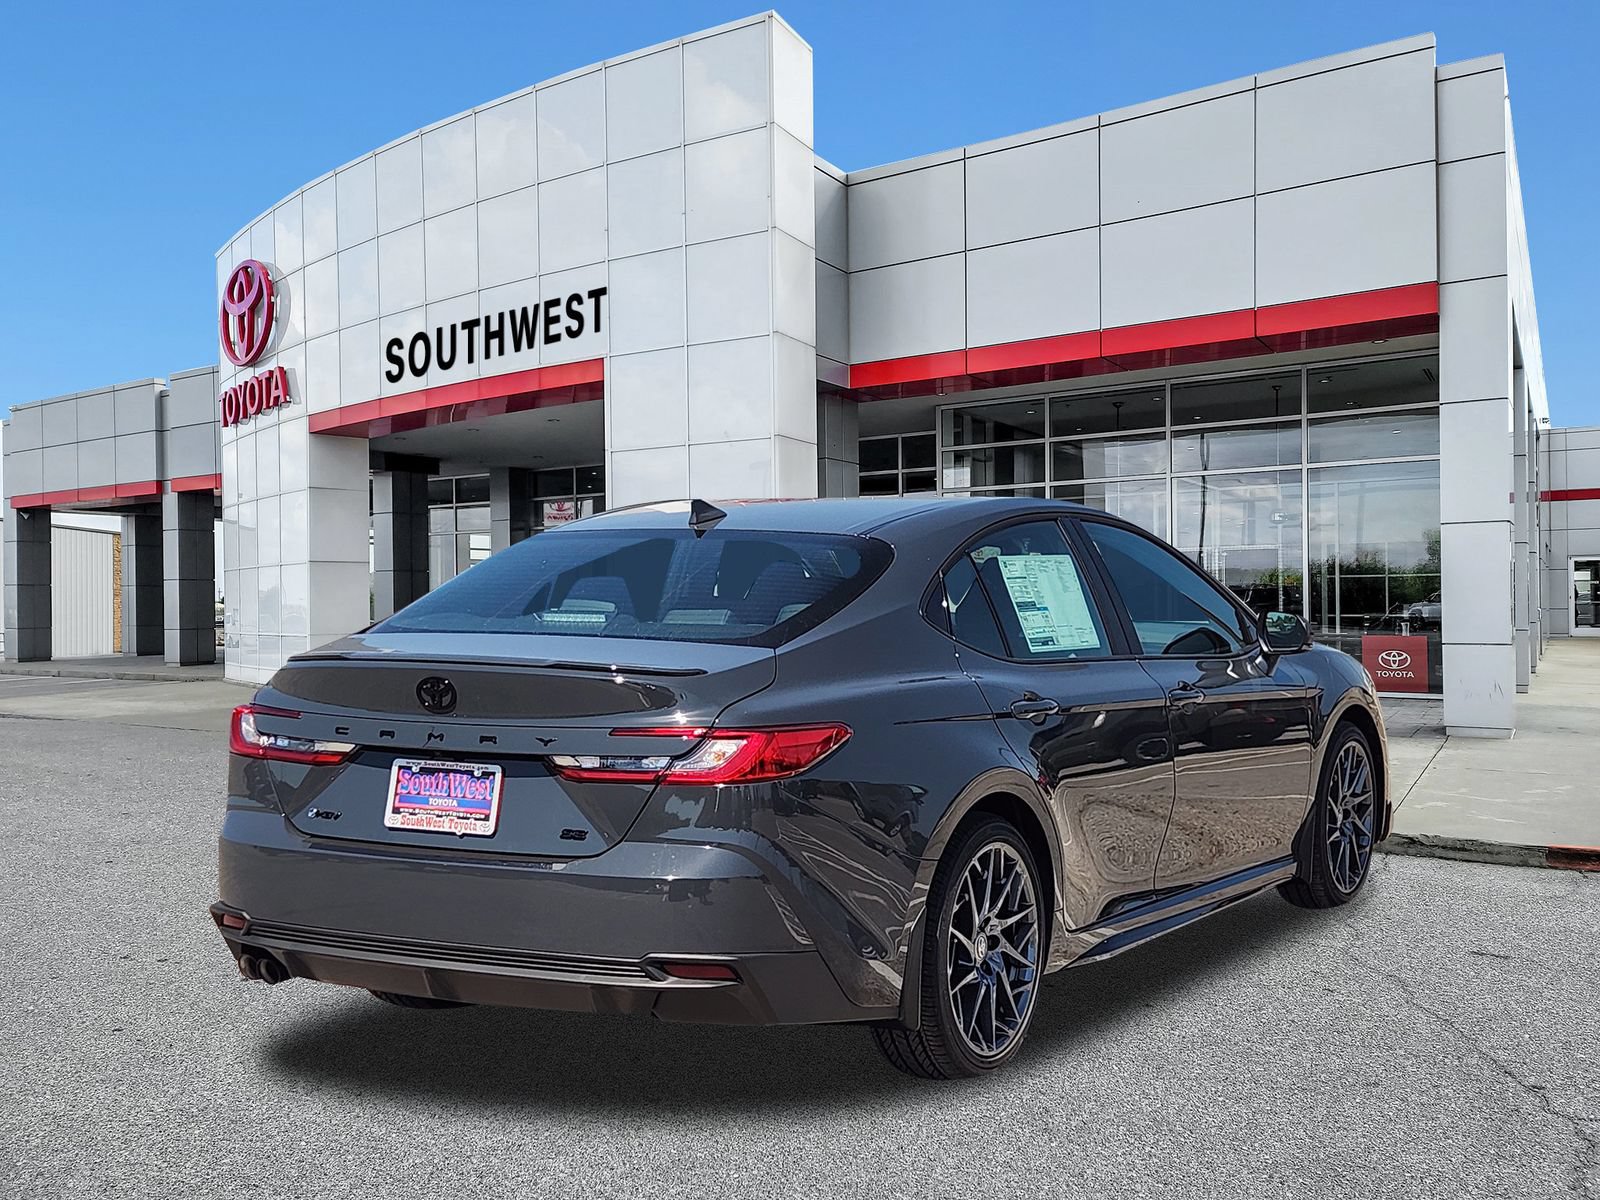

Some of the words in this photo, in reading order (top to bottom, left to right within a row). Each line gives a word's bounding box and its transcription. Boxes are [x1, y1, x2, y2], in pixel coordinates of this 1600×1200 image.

[385, 286, 608, 384] SOUTHWEST
[218, 366, 291, 428] TOYOTA
[335, 727, 558, 746] CAMRY
[397, 769, 494, 800] SouthWest
[429, 798, 458, 807] TOYOTA
[401, 815, 445, 829] SouthWest
[447, 818, 478, 833] Toyota
